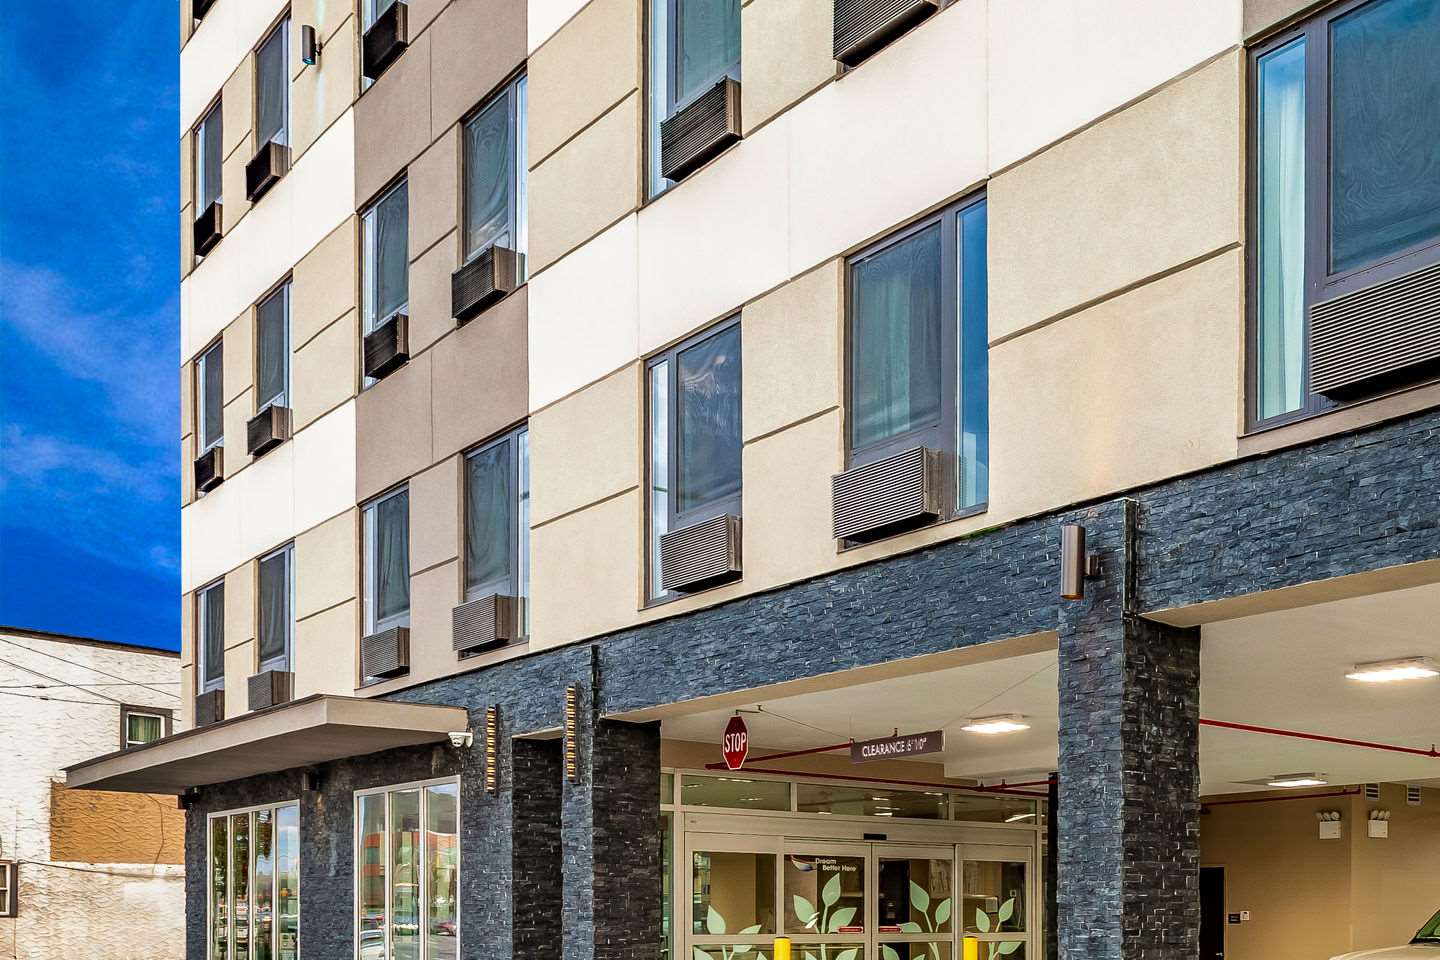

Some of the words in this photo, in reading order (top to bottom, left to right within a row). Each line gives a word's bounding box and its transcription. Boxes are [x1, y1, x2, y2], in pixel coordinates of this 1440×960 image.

[725, 732, 747, 753] STOP
[862, 740, 905, 757] CLEARANCE
[815, 857, 837, 865] Dream
[841, 864, 857, 872] Here
